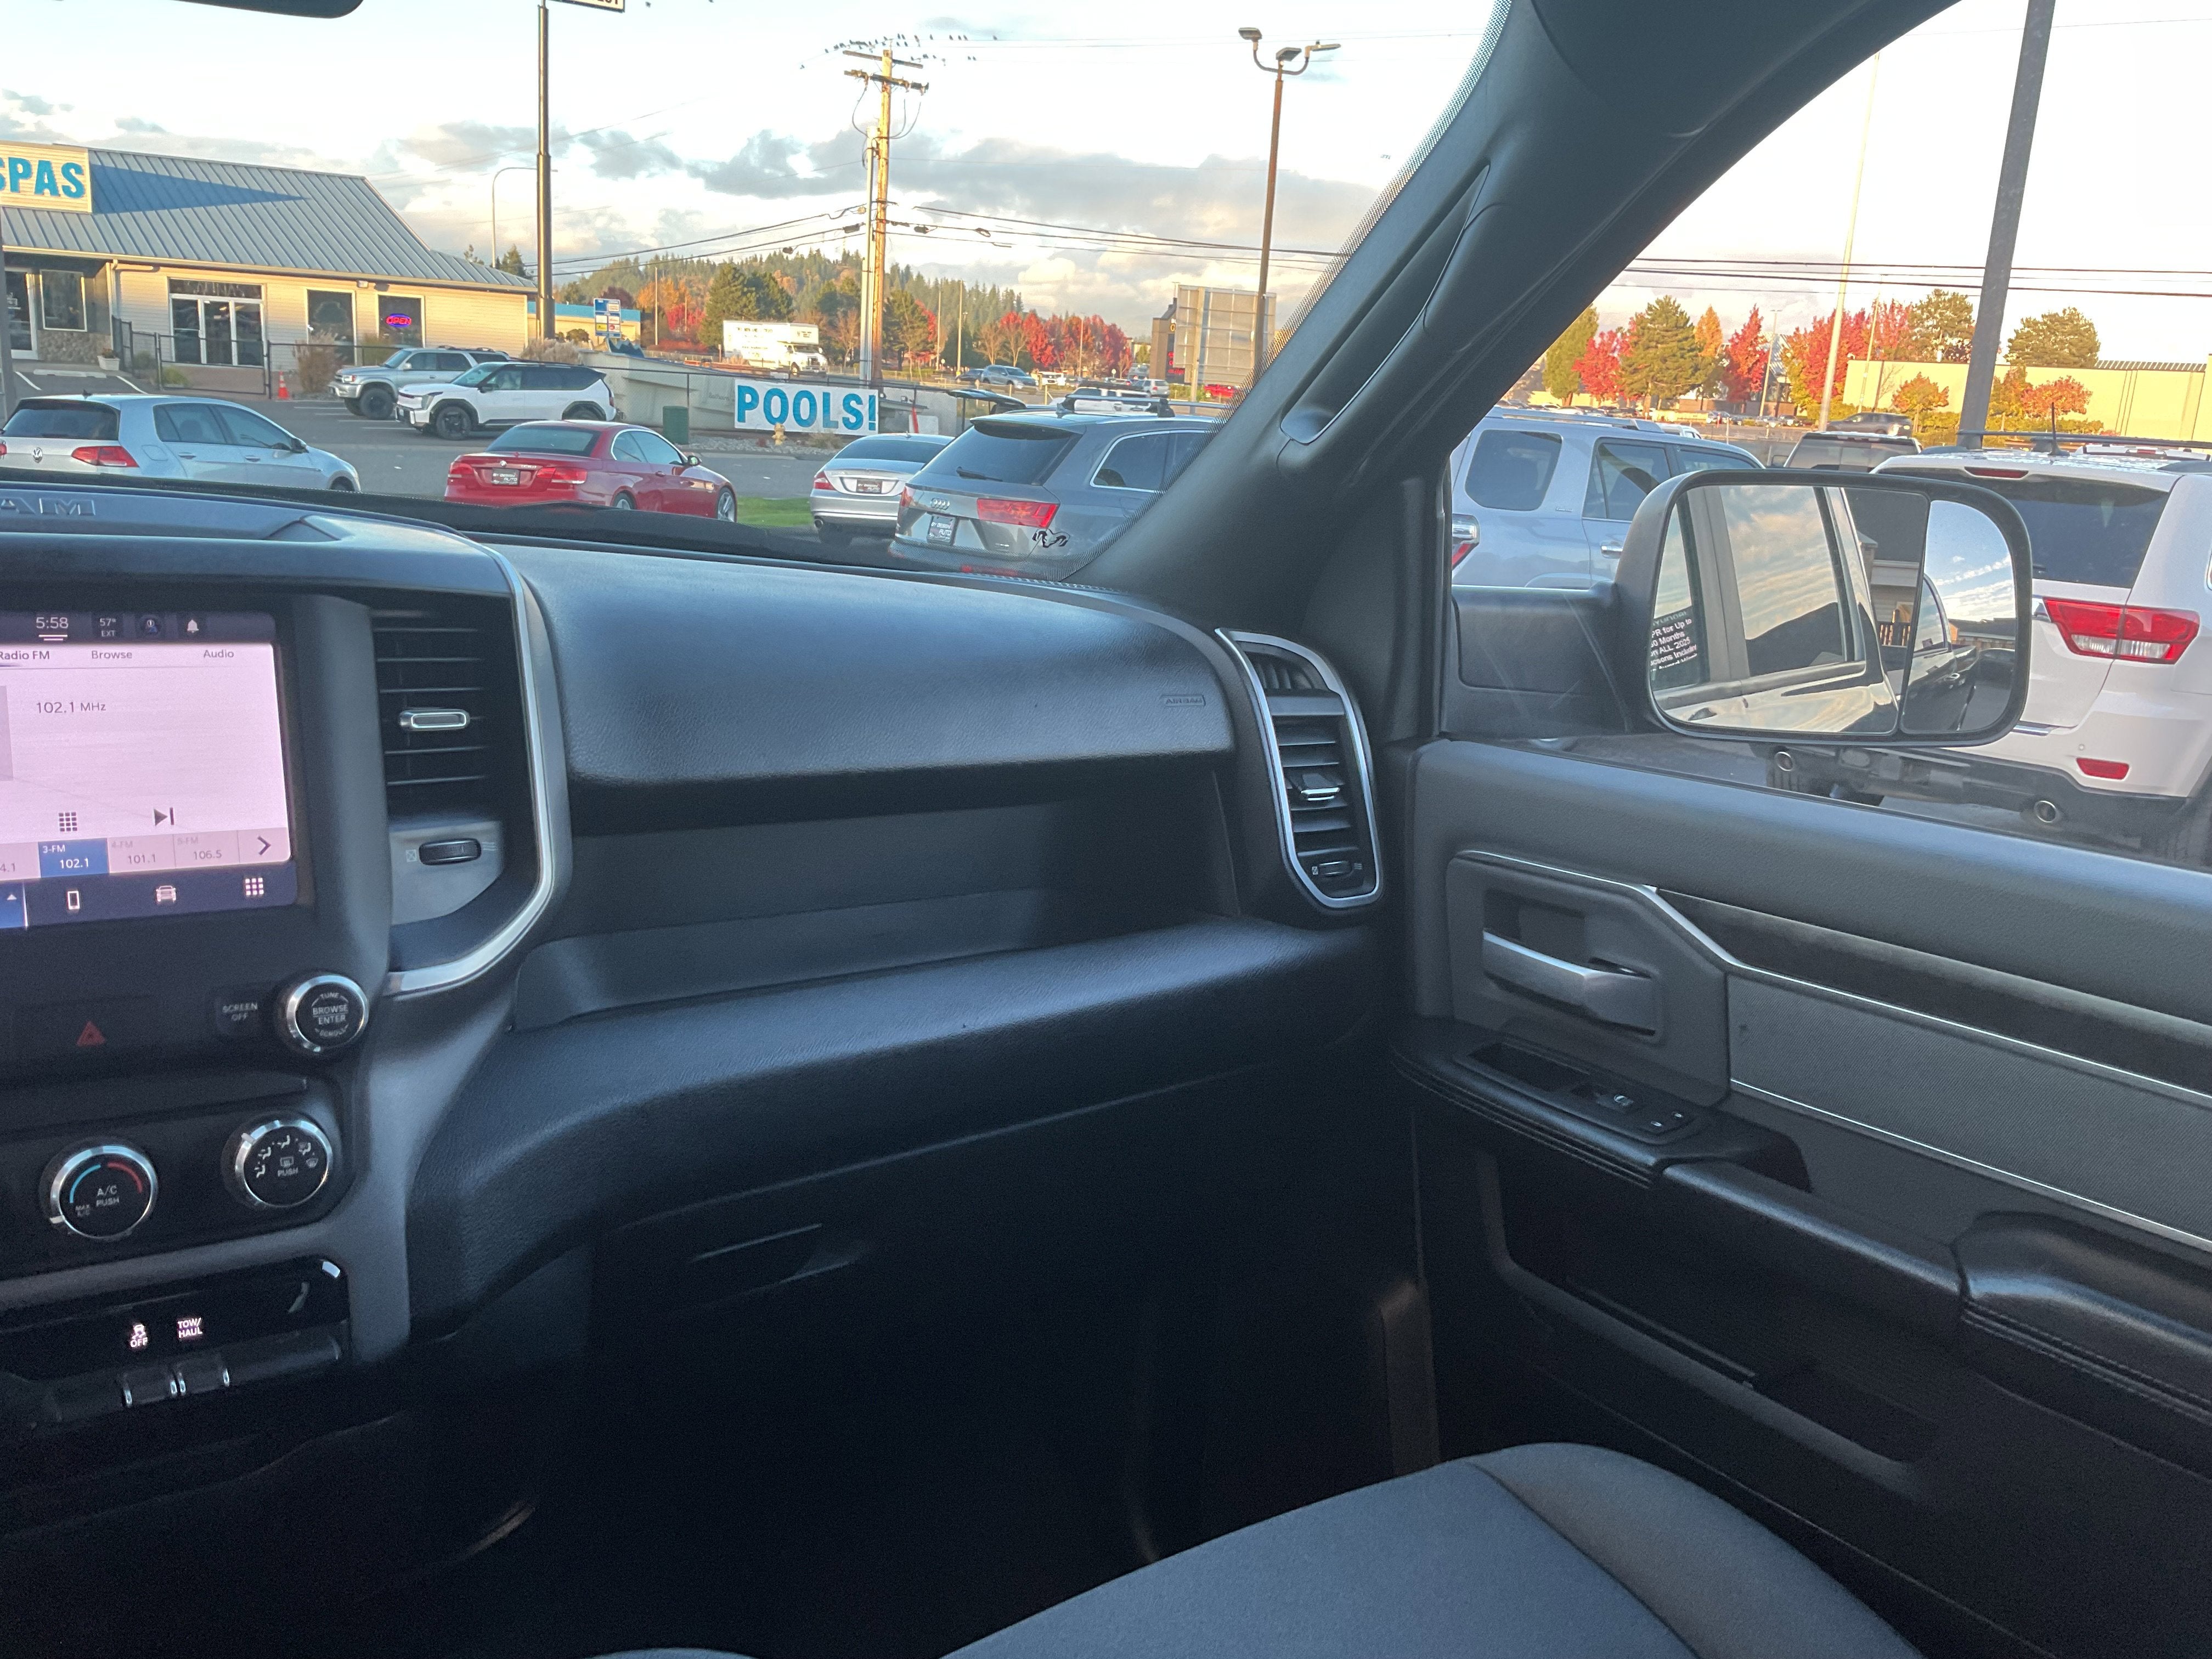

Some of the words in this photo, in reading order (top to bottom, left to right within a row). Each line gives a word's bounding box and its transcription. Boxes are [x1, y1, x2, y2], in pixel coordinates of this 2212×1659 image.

[0, 156, 85, 199] PAS
[386, 316, 411, 325] OPEN
[737, 385, 876, 431] POOLS!
[36, 616, 69, 629] 5:58
[1662, 625, 1674, 634] for
[1658, 631, 1685, 645] Months
[32, 650, 50, 659] FM
[91, 650, 132, 659] Browse
[204, 649, 234, 658] Audio
[1659, 645, 1674, 654] ALL
[36, 702, 75, 713] 102.1
[80, 702, 106, 711] MHz
[42, 845, 65, 854] 3-FM
[128, 854, 156, 865] 101.1
[193, 850, 222, 860] 106.5
[60, 858, 89, 869] 102.1
[222, 1002, 258, 1013] SCREEN
[313, 1005, 349, 1015] BROWSE
[231, 1013, 249, 1022] OFF
[318, 1014, 346, 1025] ENTER
[278, 1167, 298, 1177] PUSH
[97, 1185, 117, 1196] A/C
[96, 1197, 119, 1206] PUSH
[177, 1317, 202, 1329] TOW/
[178, 1327, 203, 1339] HAUL
[130, 1337, 148, 1347] OFF
